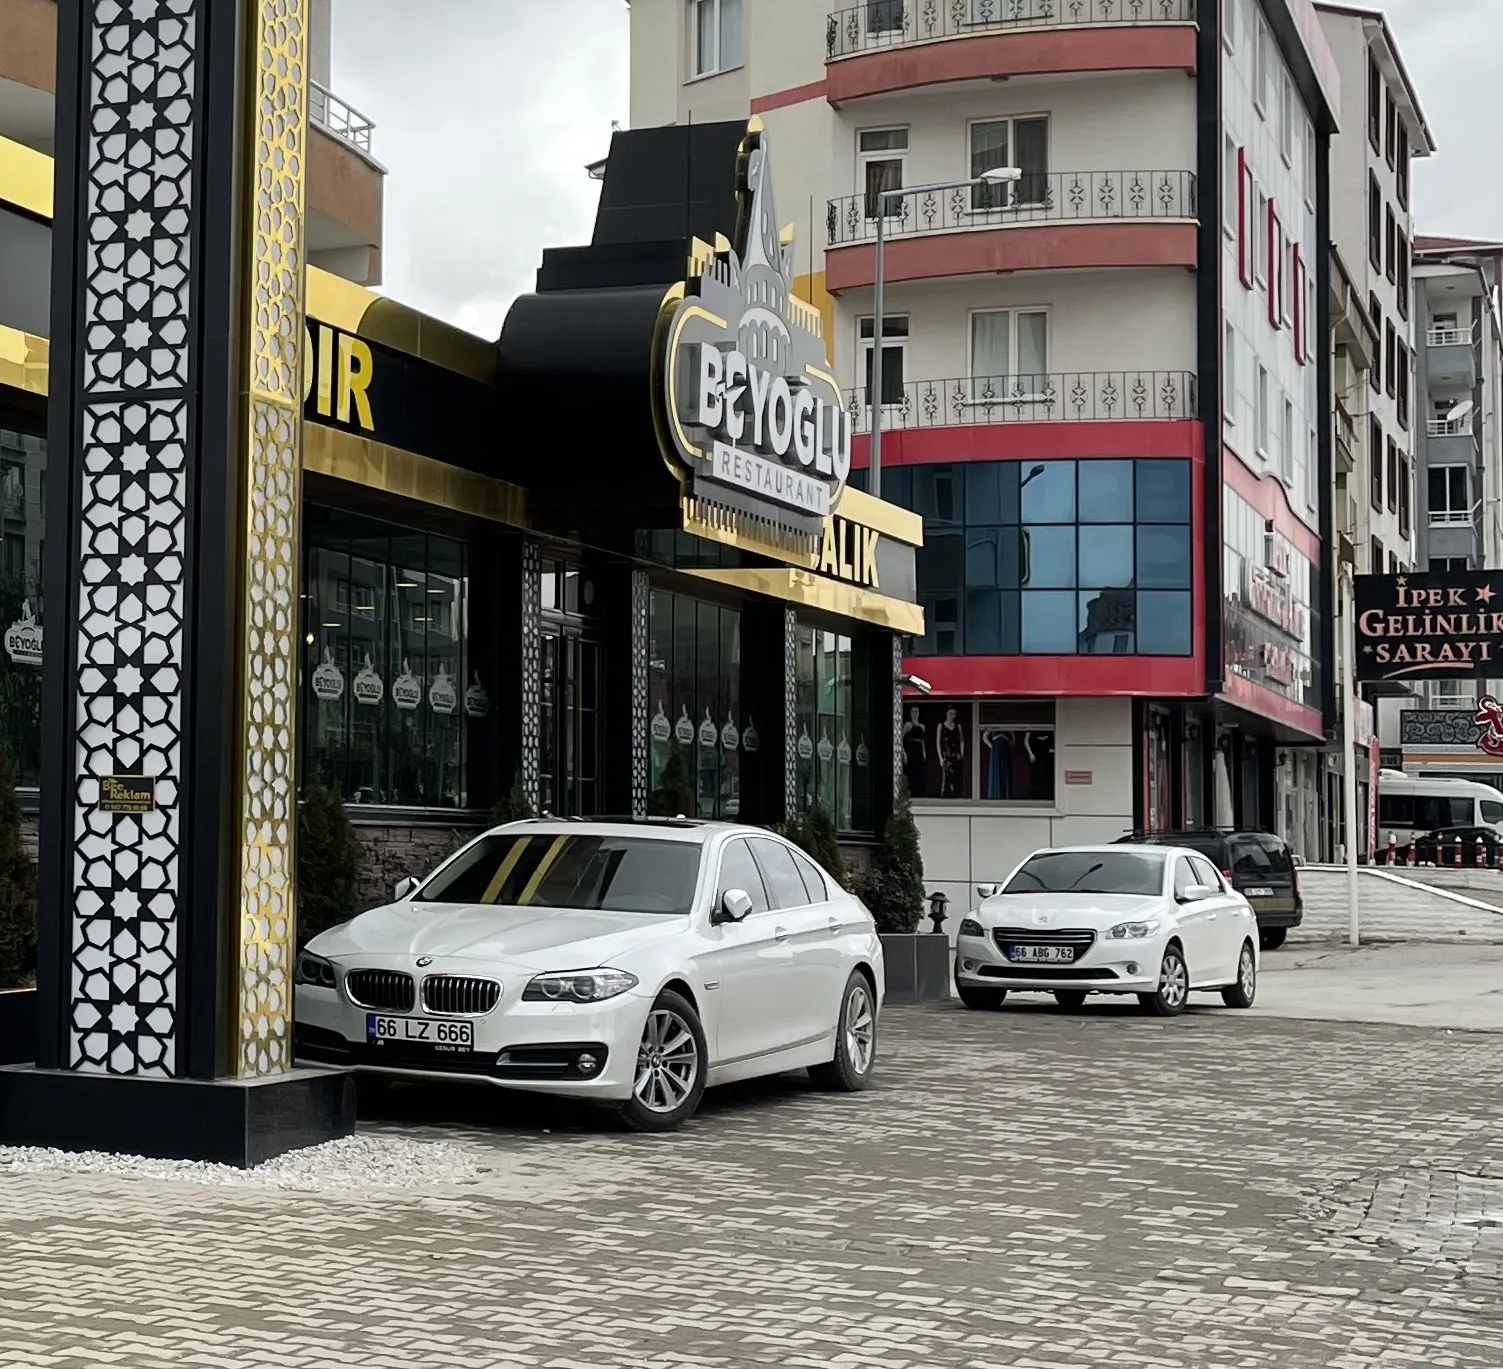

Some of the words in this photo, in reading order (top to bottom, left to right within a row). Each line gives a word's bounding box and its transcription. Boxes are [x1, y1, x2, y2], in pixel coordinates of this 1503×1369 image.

[721, 450, 823, 510] RESTAURANT
[813, 516, 880, 588] ALIK
[1395, 576, 1468, 608] İPEK
[1376, 642, 1493, 664] SARAYI
[1055, 947, 1073, 959] 762
[377, 1018, 397, 1037] 66
[405, 1020, 430, 1040] LZ
[437, 1023, 470, 1043] 666
